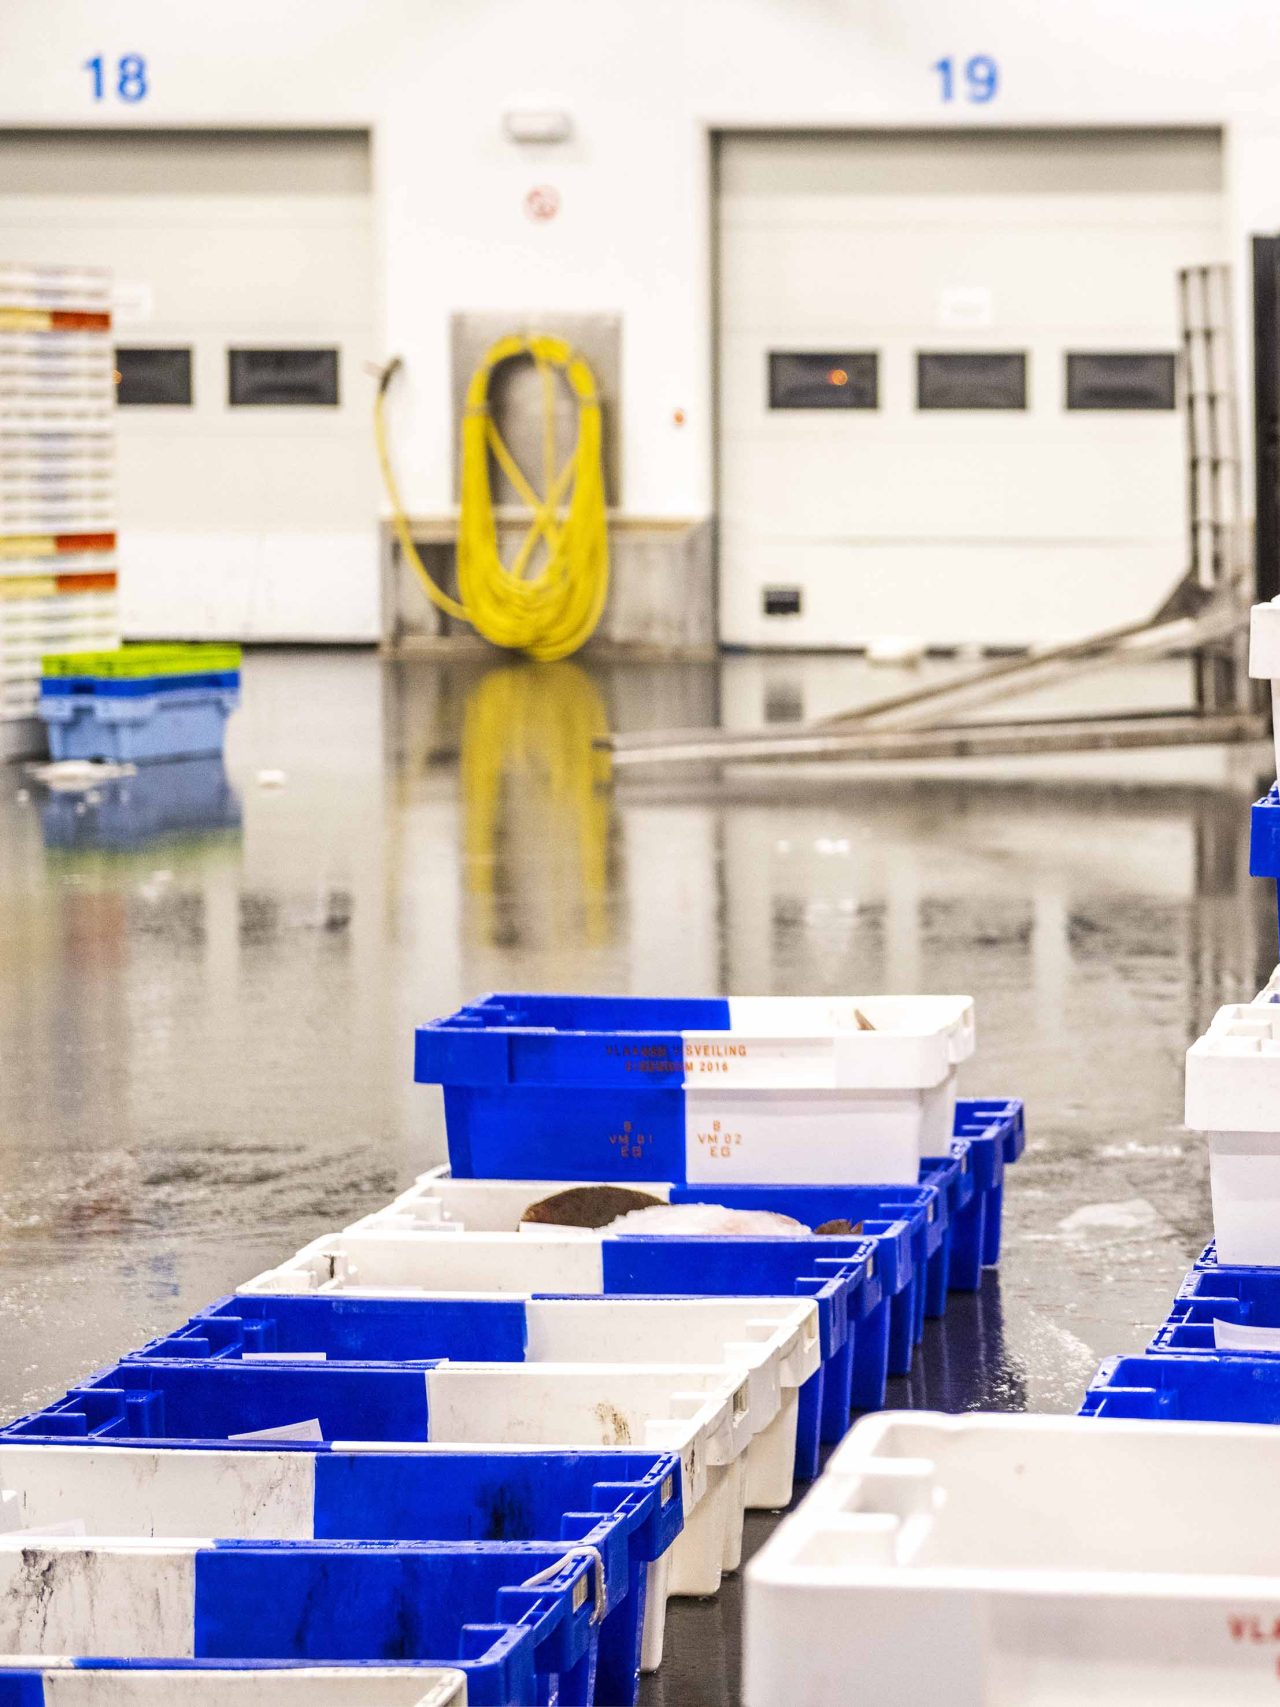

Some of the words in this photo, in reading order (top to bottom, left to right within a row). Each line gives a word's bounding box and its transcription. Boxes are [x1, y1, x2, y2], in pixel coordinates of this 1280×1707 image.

[84, 54, 148, 103] 18
[934, 54, 999, 104] 19
[700, 1061, 729, 1072] 2016
[713, 1120, 721, 1131] B
[698, 1134, 718, 1144] VM
[724, 1134, 742, 1145] 02
